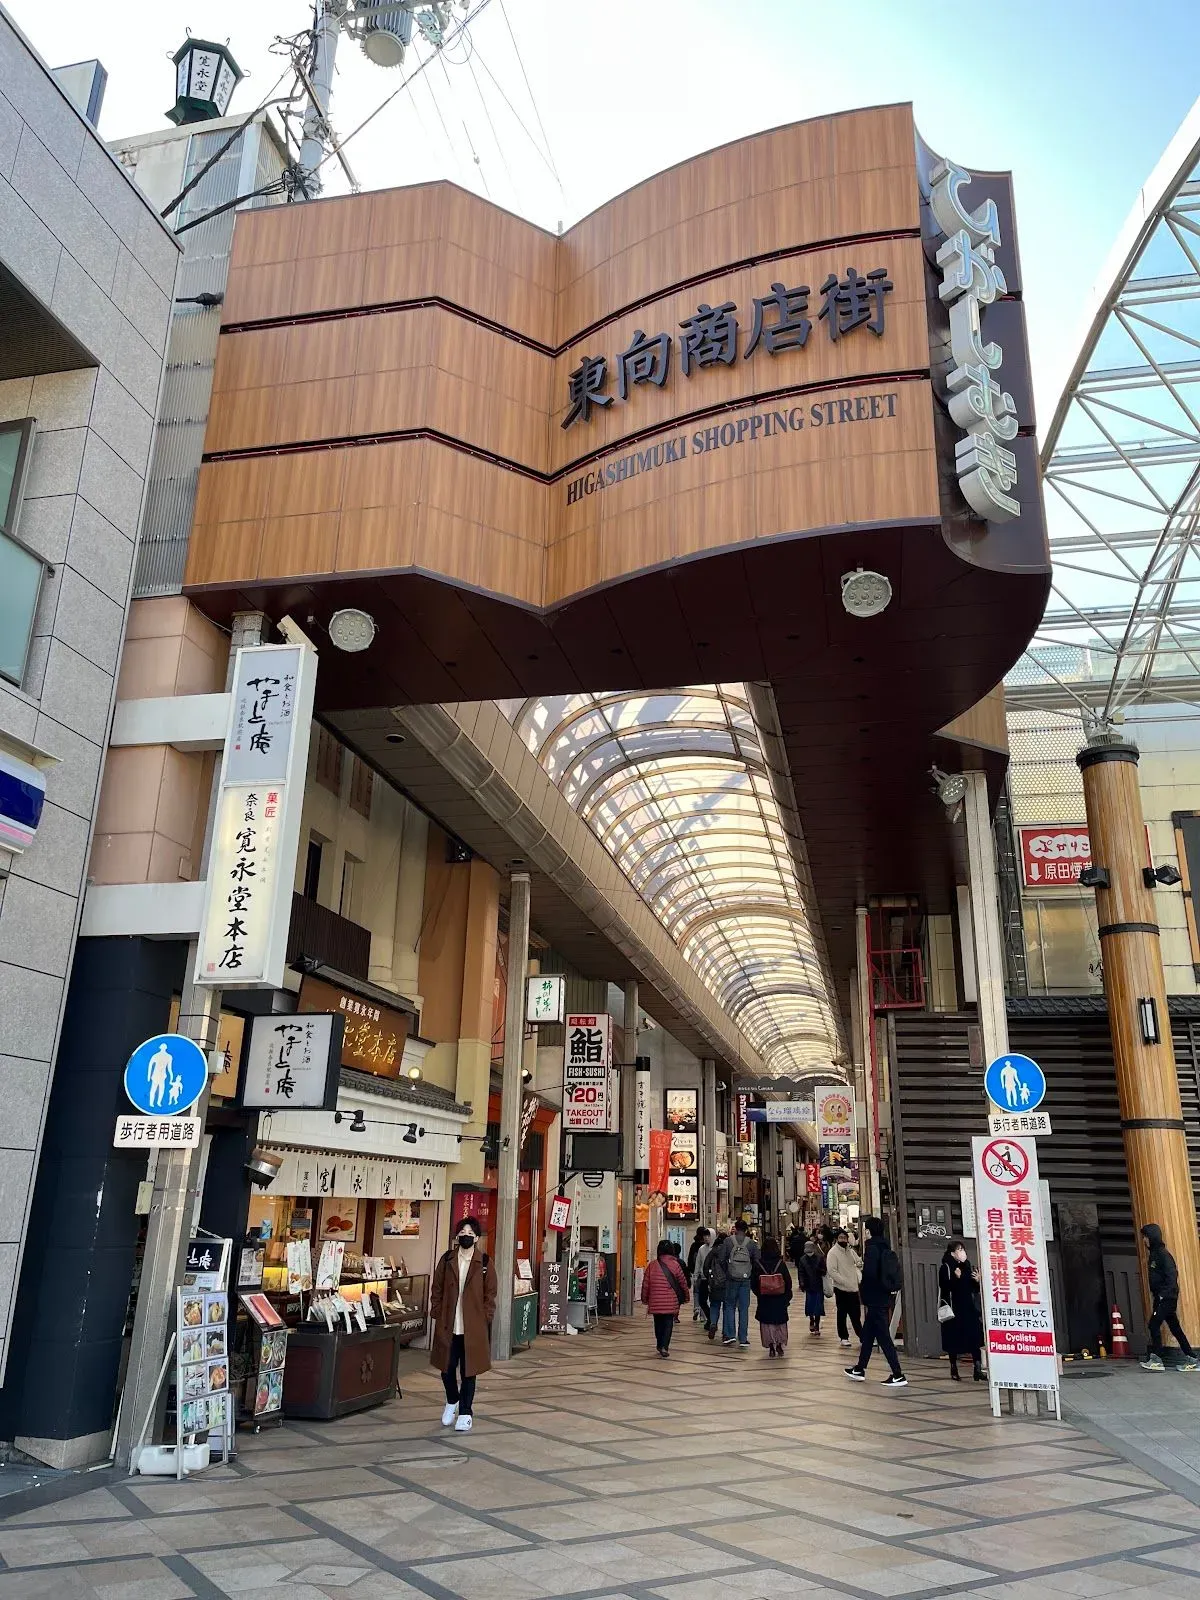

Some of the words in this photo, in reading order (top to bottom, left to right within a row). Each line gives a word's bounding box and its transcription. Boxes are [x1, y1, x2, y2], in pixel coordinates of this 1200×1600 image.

[561, 267, 894, 430] 東向商店街
[931, 158, 1021, 523] ひがしむき
[566, 435, 687, 505] HIGASHIMUKI
[692, 408, 804, 455] SHOPPING
[810, 393, 897, 430] STREET
[247, 677, 280, 754] やまと庵
[244, 793, 258, 822] 奈良
[264, 792, 278, 818] 菓匠
[218, 827, 257, 969] 寛永堂本店
[302, 1022, 314, 1063] 和食とお酒
[569, 1027, 603, 1063] 鮨
[275, 1024, 303, 1098] やまと庵
[120, 1122, 195, 1141] 歩行者用道路
[822, 1126, 851, 1134] ジャンカラ
[993, 1116, 1047, 1132] 歩行者用道路
[187, 1248, 213, 1270] と庵
[987, 1207, 1011, 1303] 自行車請推行
[1007, 1189, 1041, 1305] 車両乗入禁止
[548, 1263, 560, 1295] 柿の葉
[548, 1303, 560, 1325] 茶屋
[990, 1307, 1047, 1318] 自転車は押して
[991, 1318, 1048, 1328] 通行して下さい
[990, 1342, 1016, 1351] Please
[1017, 1343, 1055, 1353] Dismount
[1005, 1333, 1037, 1343] Cyclists
